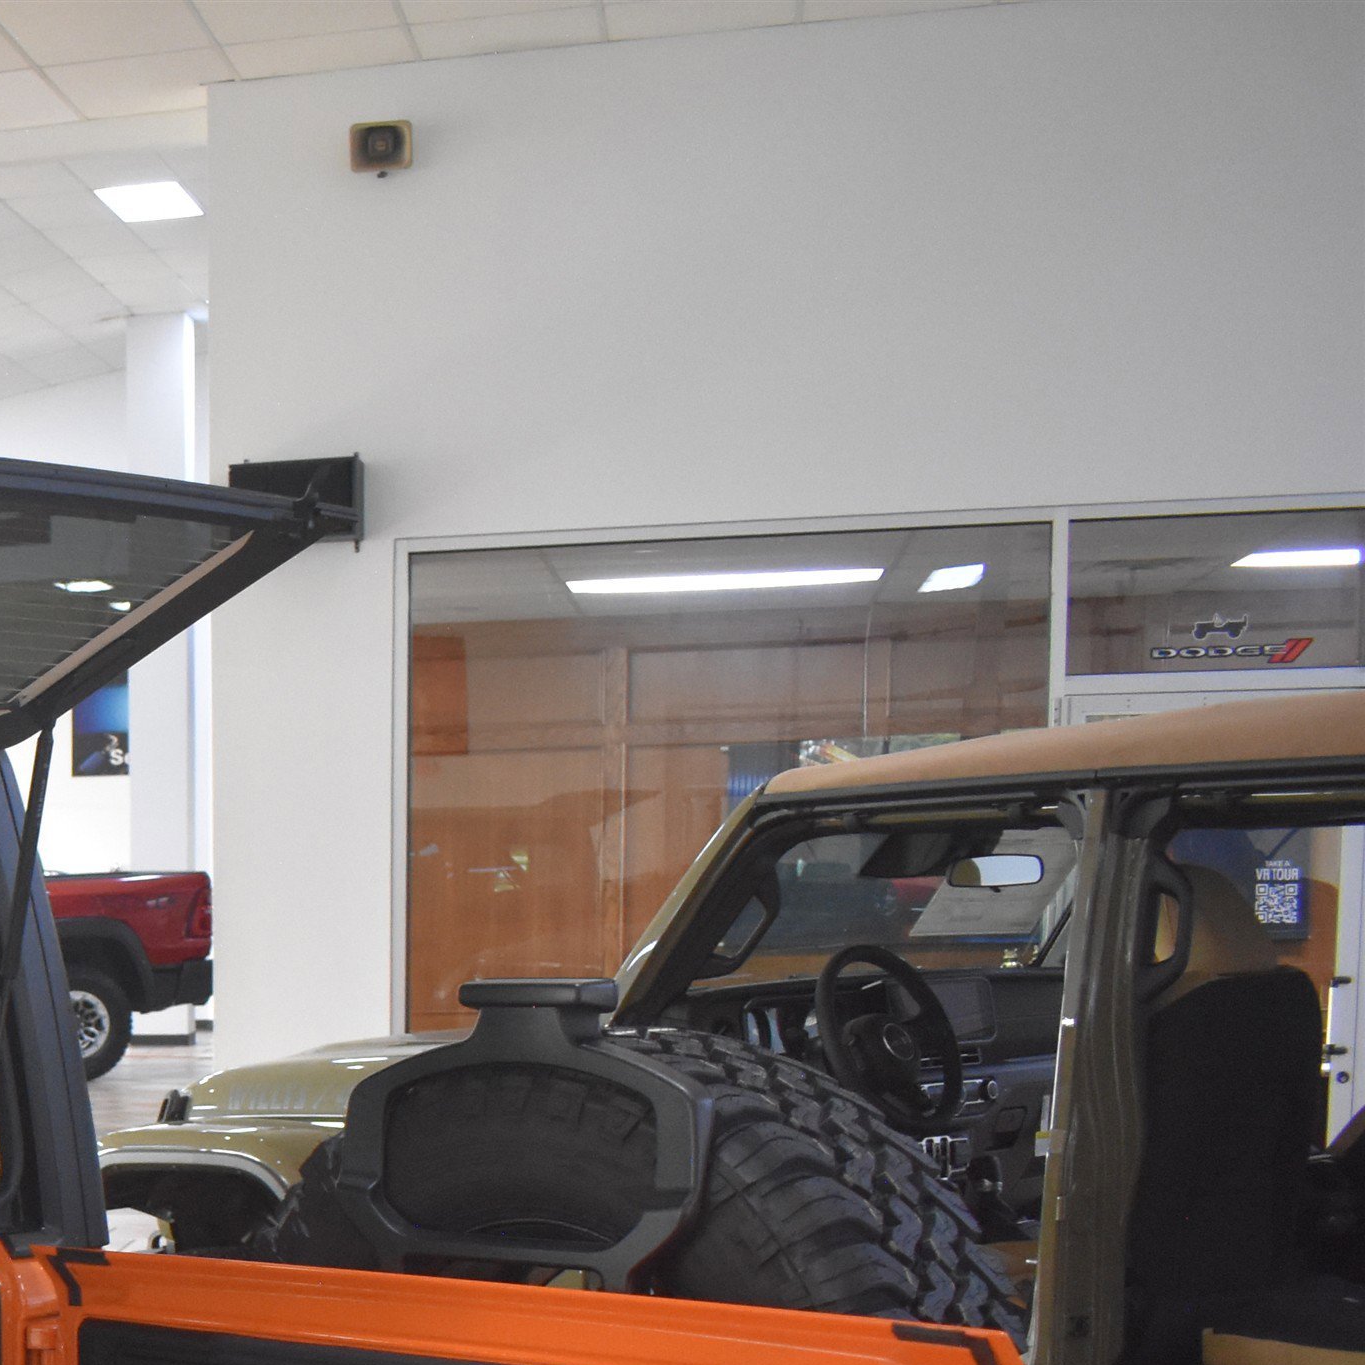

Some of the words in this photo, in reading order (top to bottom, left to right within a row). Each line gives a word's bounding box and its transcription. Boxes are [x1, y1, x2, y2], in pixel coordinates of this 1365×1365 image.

[1150, 644, 1288, 659] DODGE
[1255, 868, 1270, 881] VR
[1272, 868, 1299, 881] TOUR
